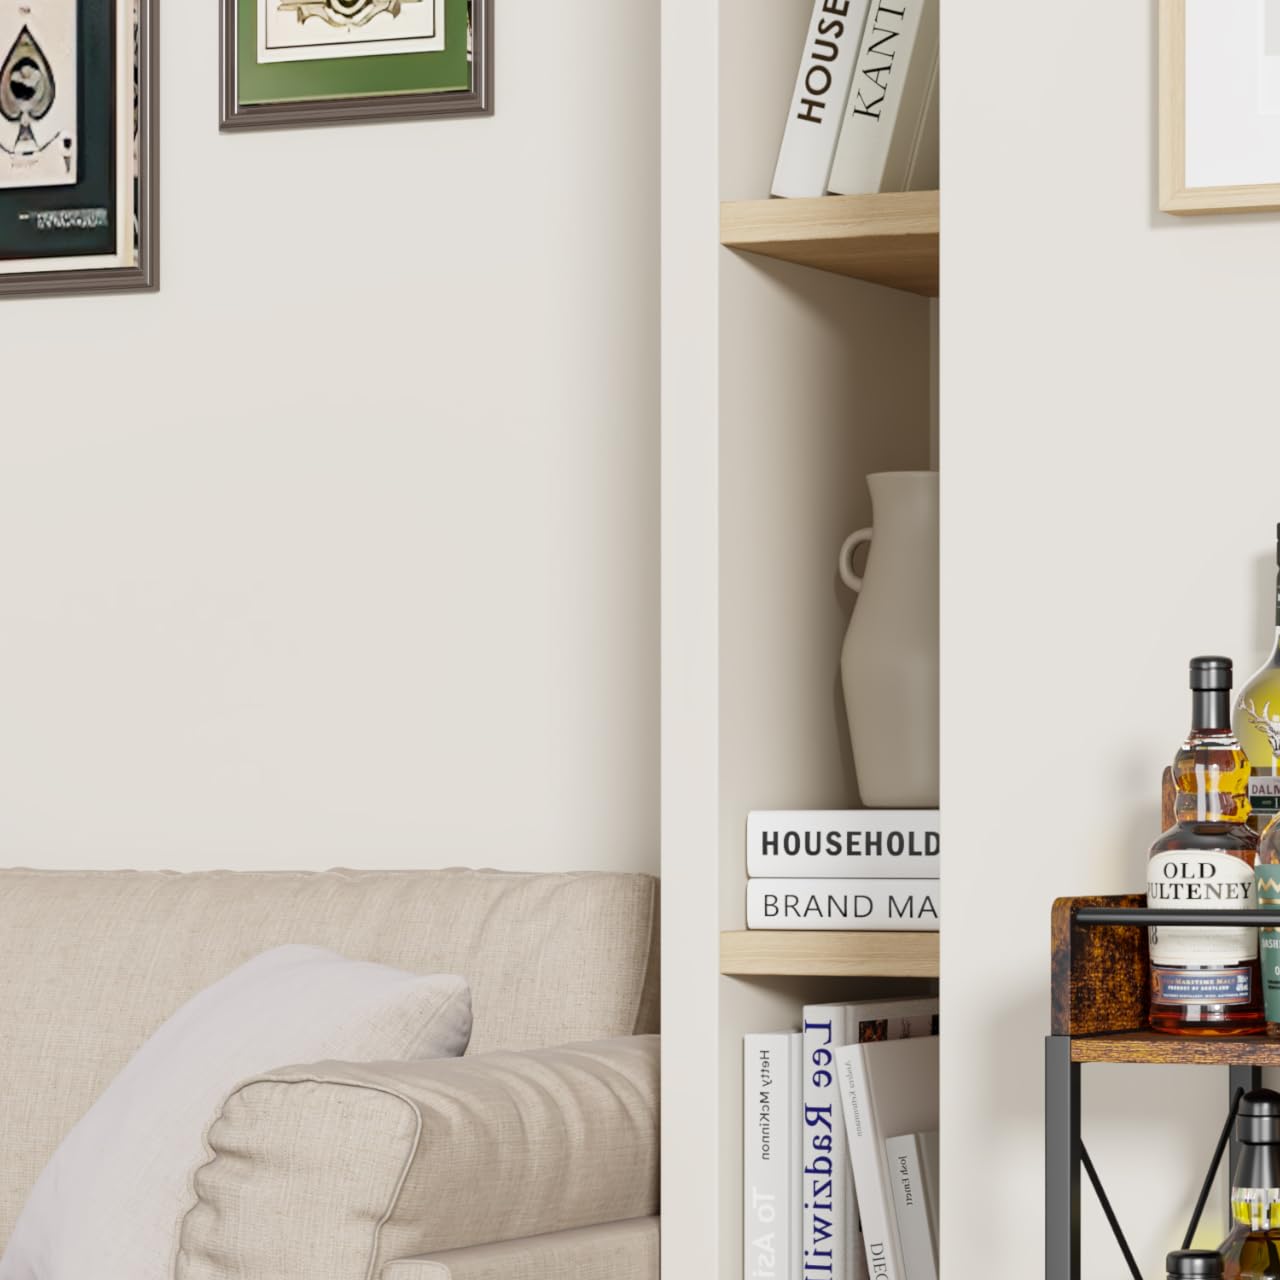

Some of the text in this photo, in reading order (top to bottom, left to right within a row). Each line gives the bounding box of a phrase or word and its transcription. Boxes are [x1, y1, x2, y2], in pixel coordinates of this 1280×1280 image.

[761, 830, 940, 857] HOUSEHOLD
[1163, 862, 1217, 879] OLD
[1149, 881, 1252, 900] ULTENEY
[763, 893, 874, 919] BRAND
